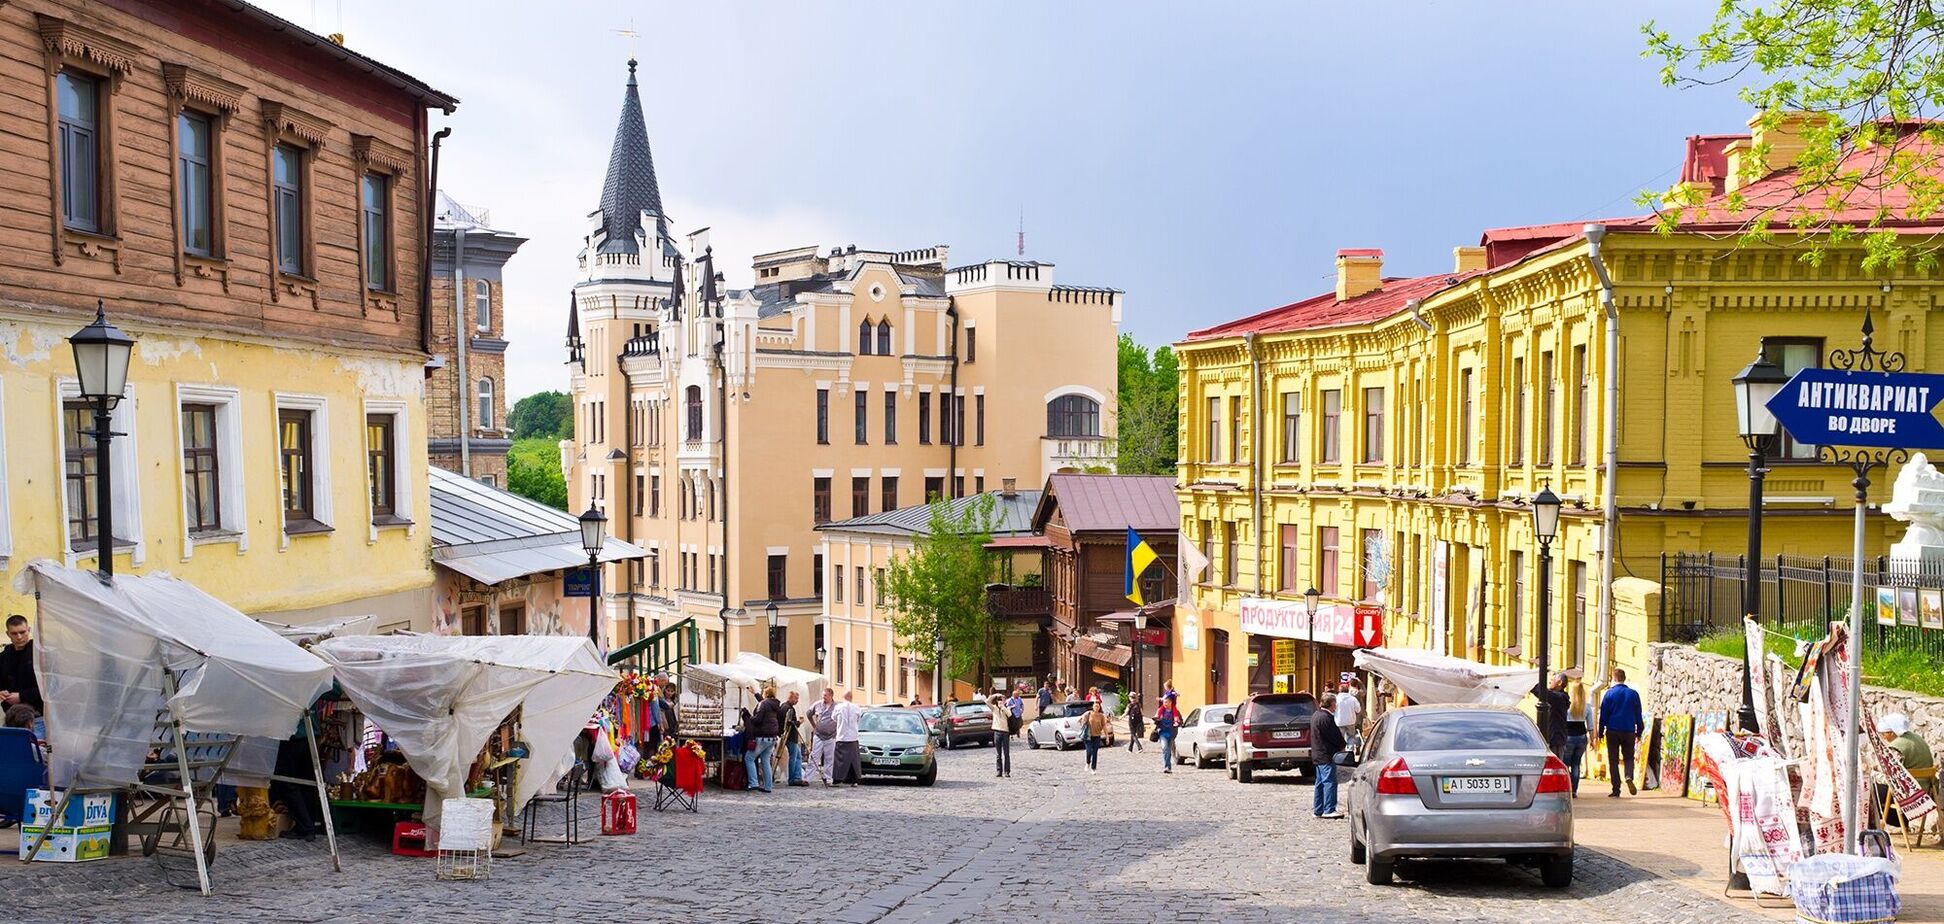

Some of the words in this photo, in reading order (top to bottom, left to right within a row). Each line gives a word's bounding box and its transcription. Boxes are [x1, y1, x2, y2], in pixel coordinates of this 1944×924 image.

[1798, 381, 1929, 413] АНТИКВАРИАТ
[1828, 416, 1848, 431] ВО
[1850, 417, 1896, 434] ДВОРЕ
[1355, 608, 1380, 616] Grocery
[1451, 780, 1463, 789] AI
[1468, 780, 1490, 789] 5033
[1495, 780, 1507, 789] BI
